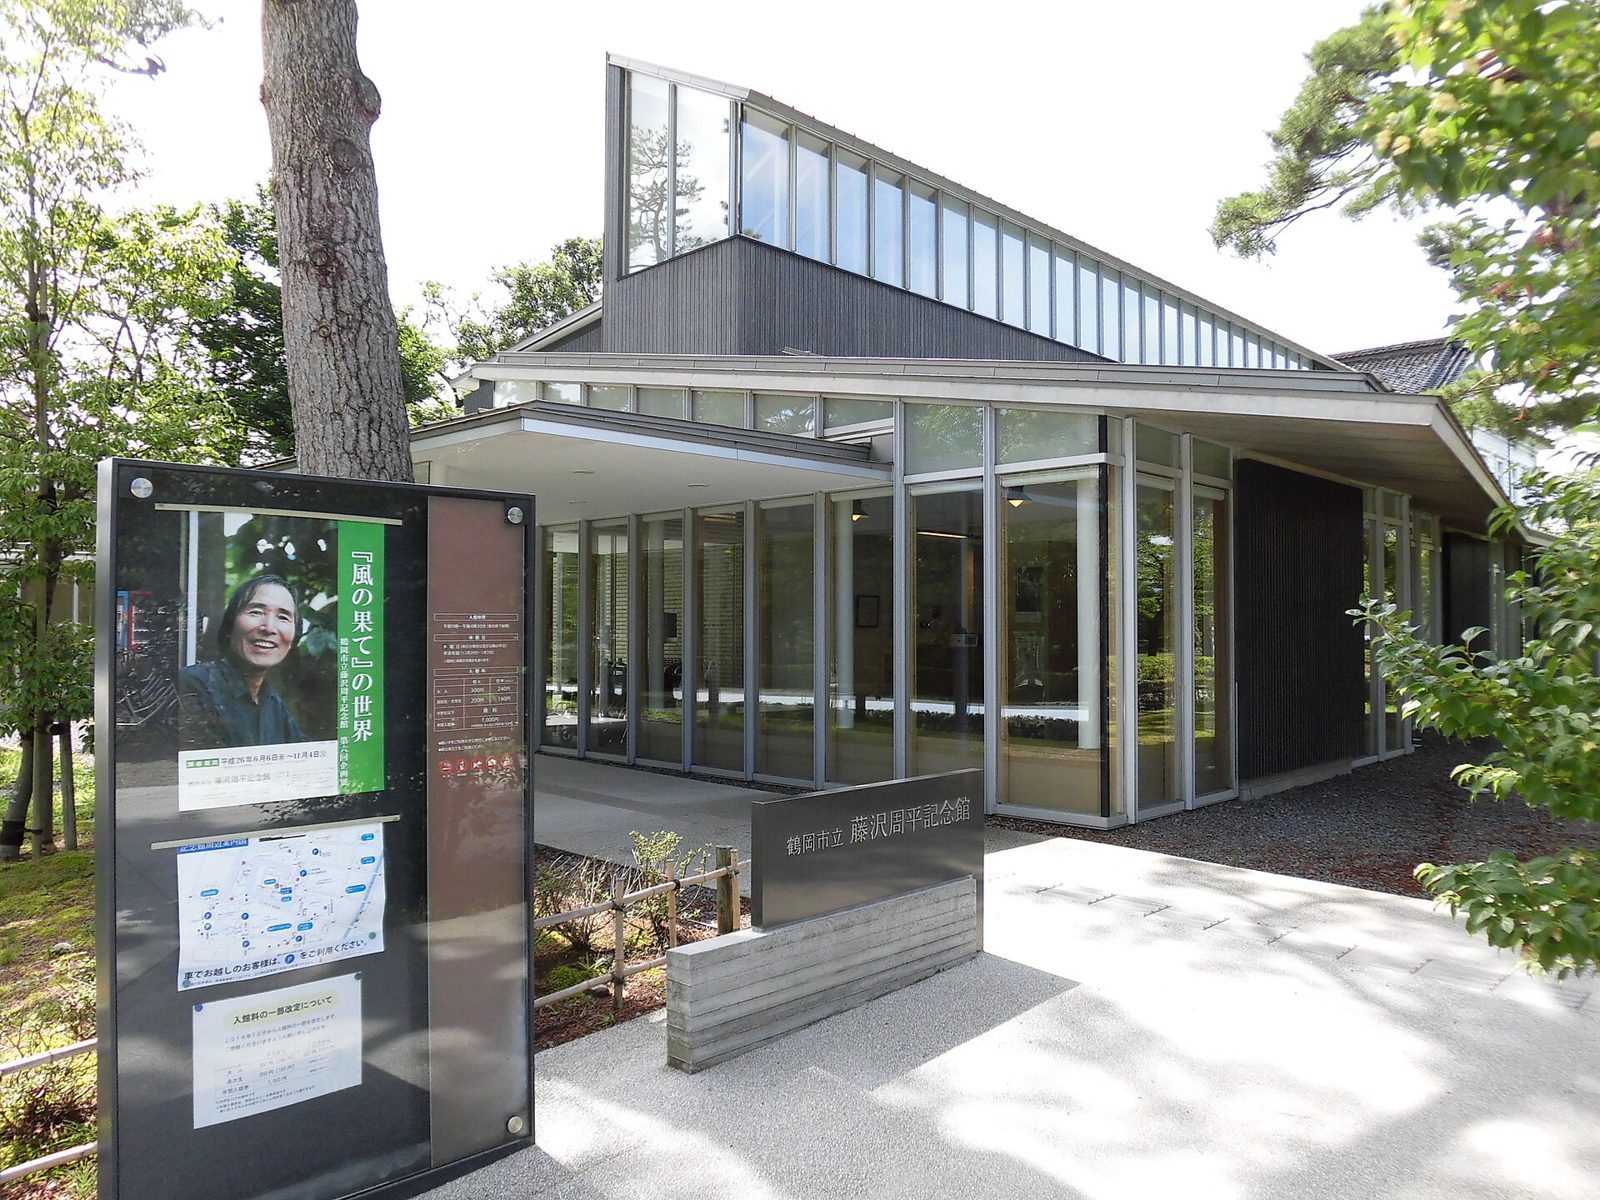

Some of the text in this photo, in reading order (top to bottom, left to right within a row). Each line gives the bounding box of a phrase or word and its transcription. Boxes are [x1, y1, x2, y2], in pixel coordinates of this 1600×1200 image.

[351, 551, 374, 743] 『風の果て』の世界
[786, 796, 971, 857] 鶴岡市立 藤沢周平記念館
[184, 959, 281, 980] 車でお越しのお客様は、
[300, 940, 367, 959] をご利用ください。
[233, 995, 333, 1026] 入館料の一部改定について
